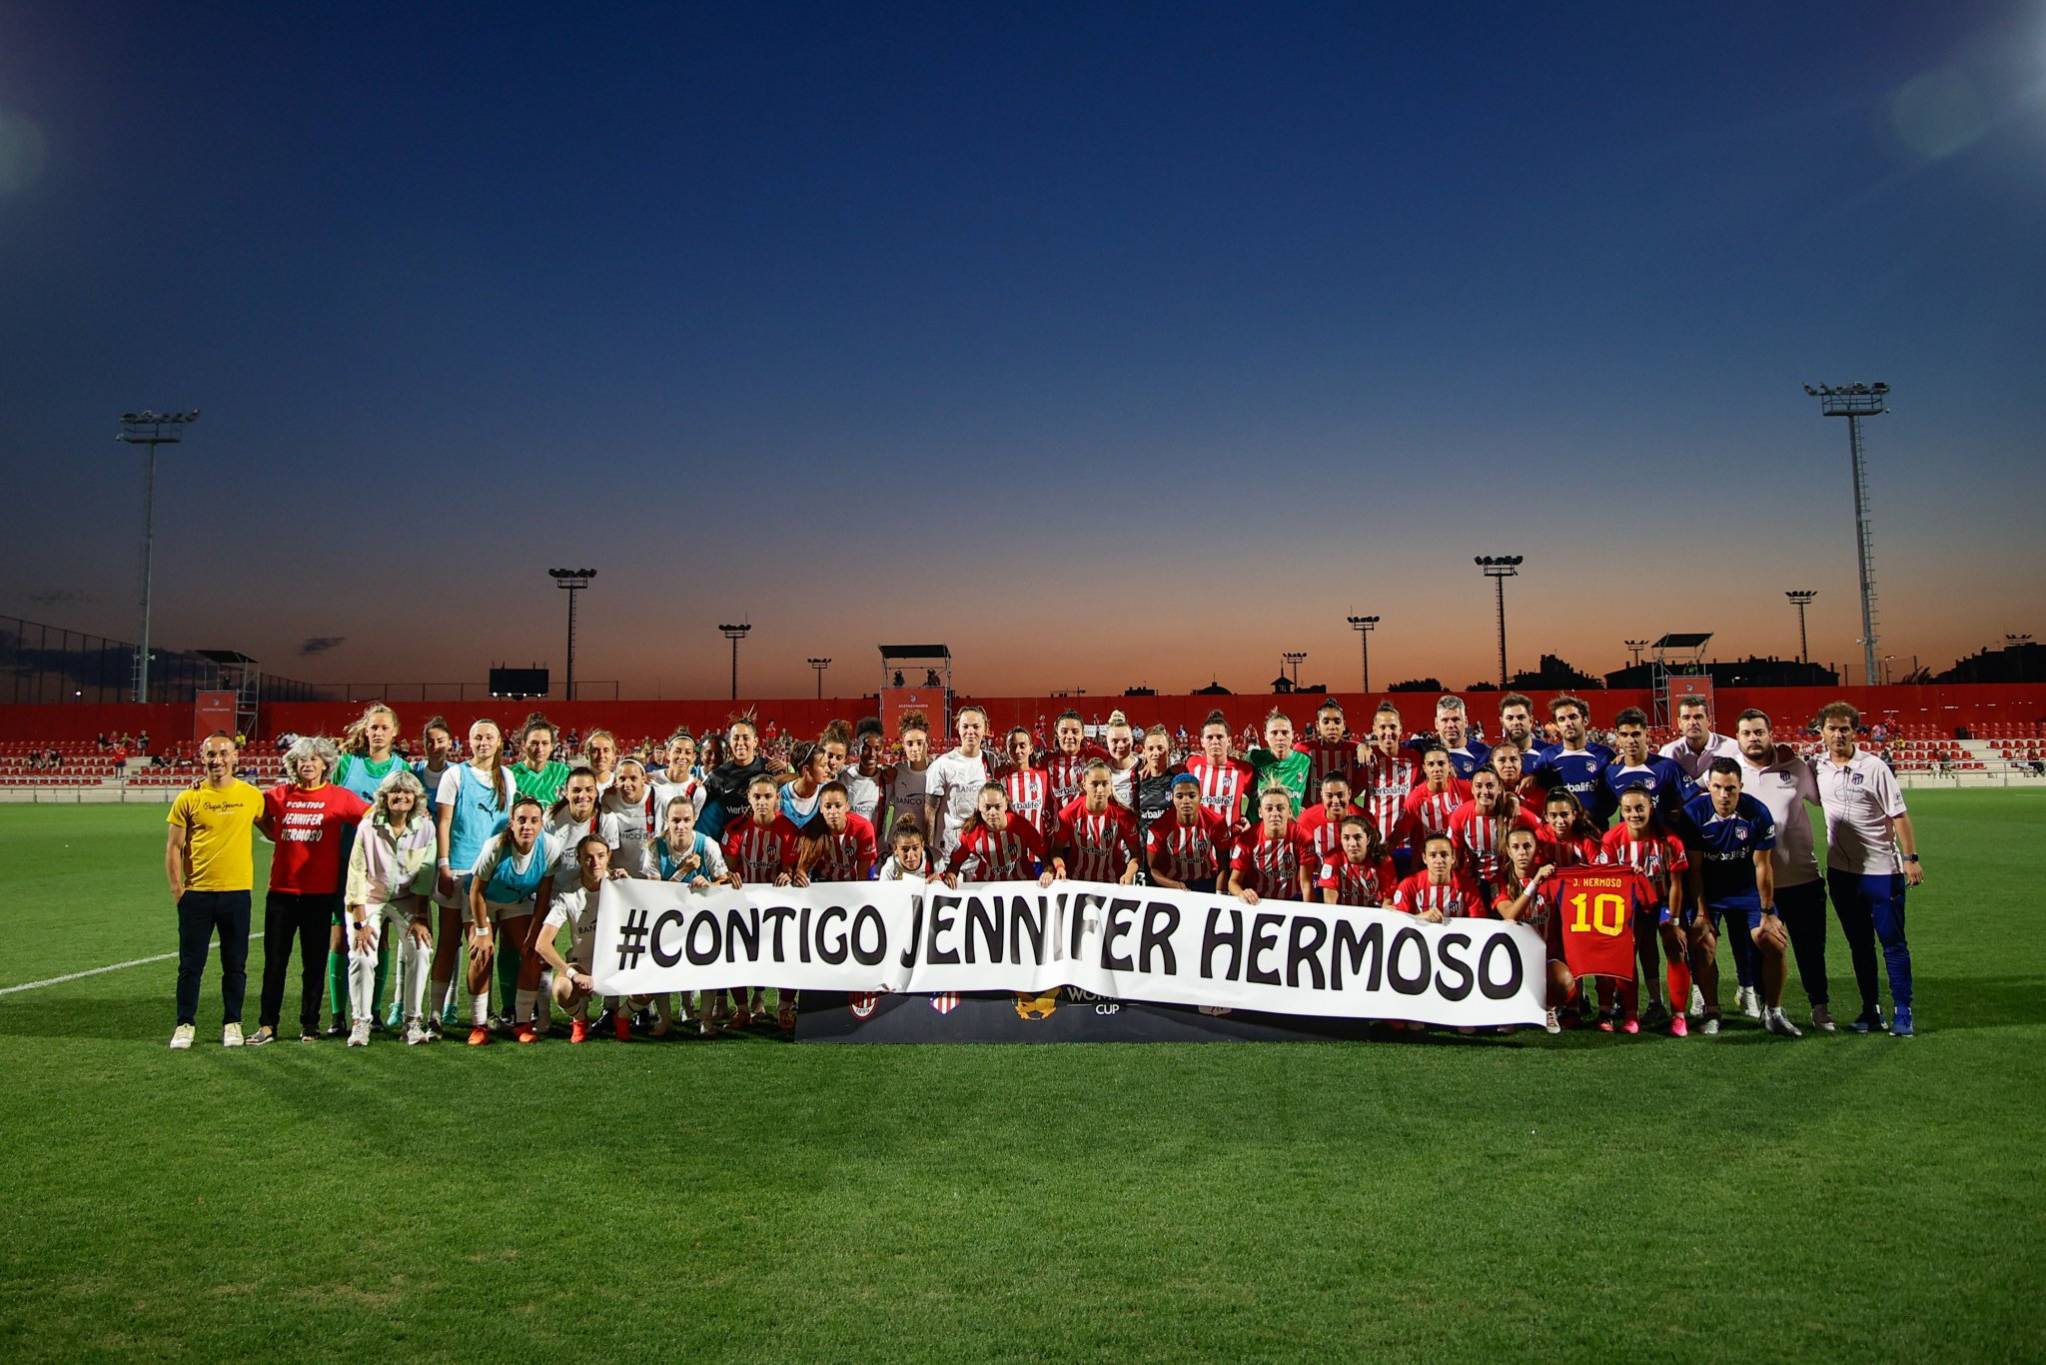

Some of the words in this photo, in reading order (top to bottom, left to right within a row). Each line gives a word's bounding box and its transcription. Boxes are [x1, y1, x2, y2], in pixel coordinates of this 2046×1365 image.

[282, 813, 324, 826] JENNIFER
[281, 828, 324, 842] HERMOSO
[1583, 878, 1622, 887] HERMOSO
[1570, 892, 1625, 937] 10
[616, 904, 887, 970] #CONTIGO
[900, 893, 1180, 976] JENNIFER
[1200, 907, 1523, 1001] HERMOSO
[1095, 1003, 1120, 1015] CUP
